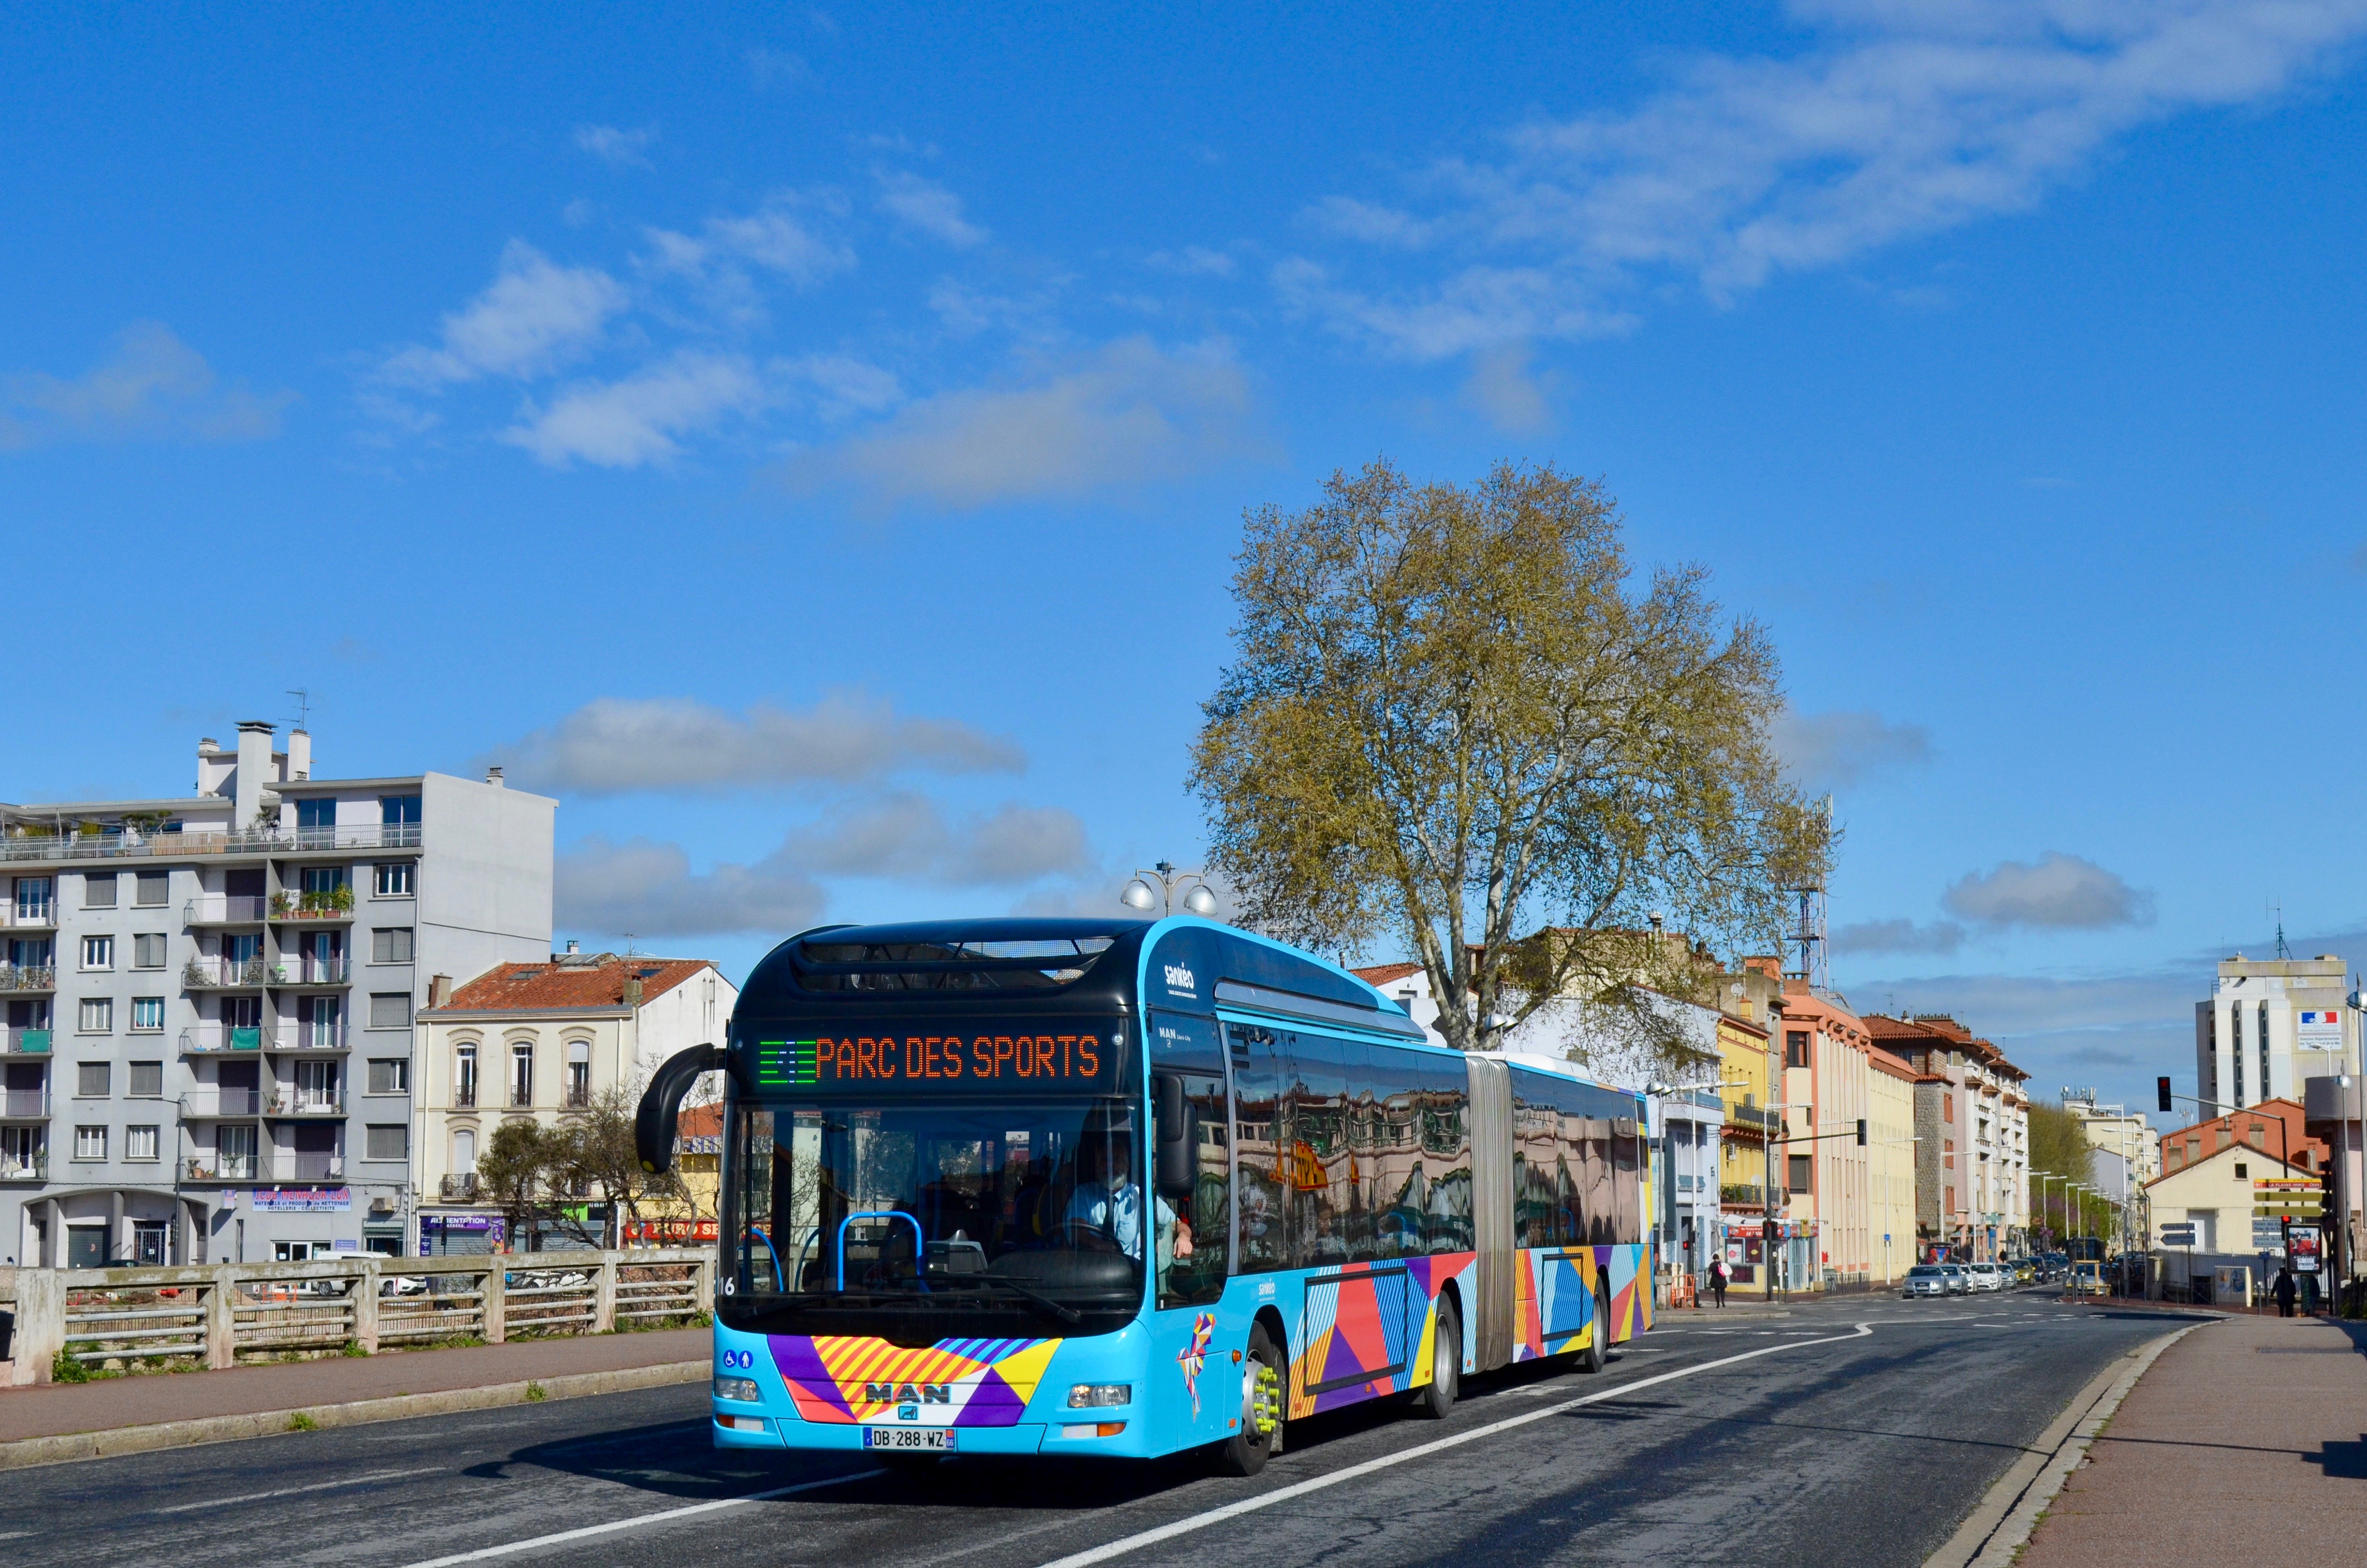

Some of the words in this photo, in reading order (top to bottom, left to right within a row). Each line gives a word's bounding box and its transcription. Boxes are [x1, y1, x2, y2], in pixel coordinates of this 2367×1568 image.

[1164, 962, 1194, 989] sankéo
[1159, 1027, 1176, 1039] MAN
[816, 1038, 896, 1078] PARC
[906, 1037, 962, 1078] DES
[973, 1035, 1098, 1077] SPORTS
[1258, 1278, 1276, 1296] sankéo
[866, 1383, 951, 1404] MAN
[874, 1430, 943, 1447] DB-288-WZ
